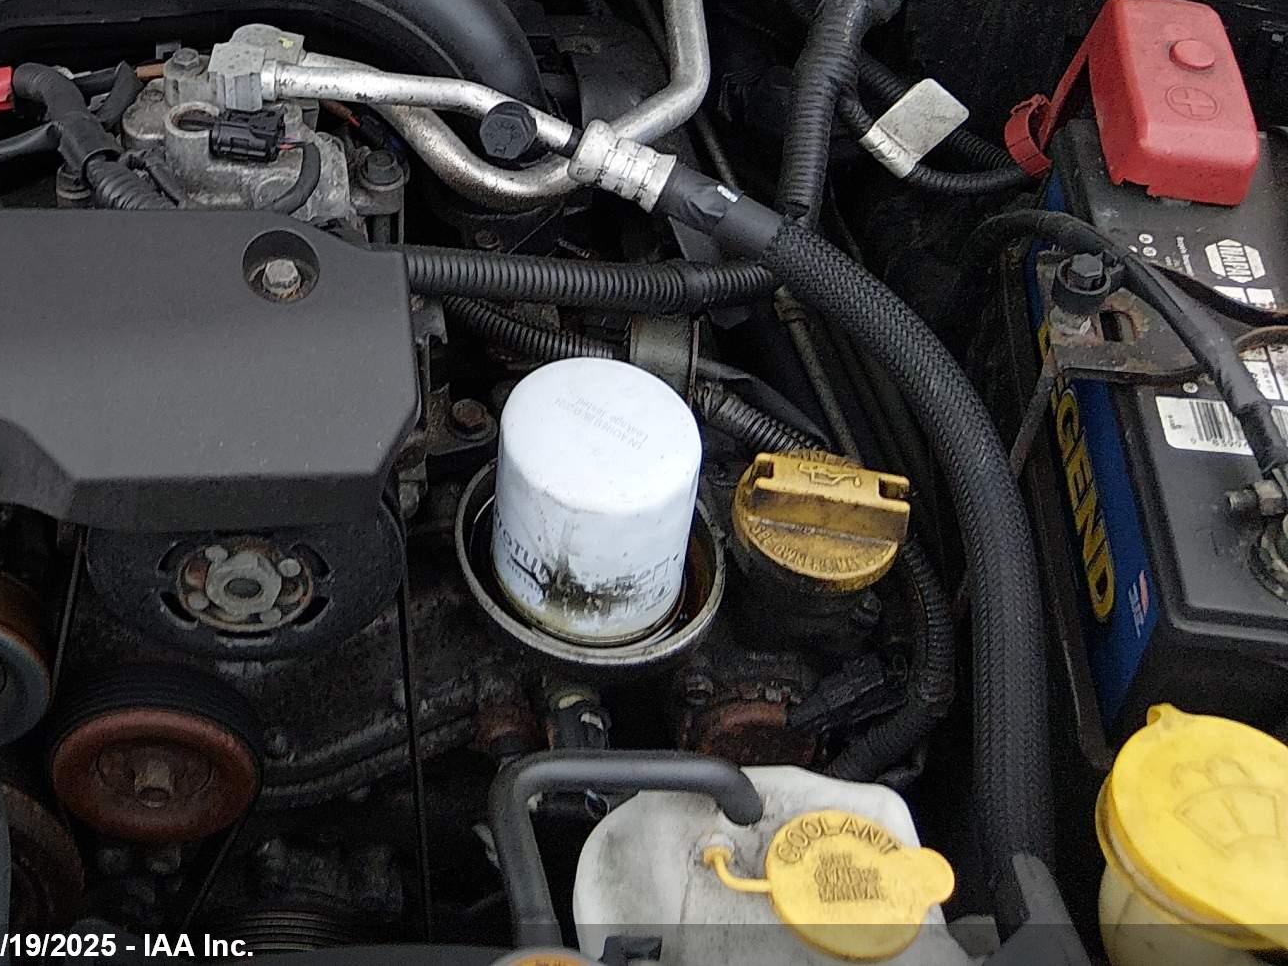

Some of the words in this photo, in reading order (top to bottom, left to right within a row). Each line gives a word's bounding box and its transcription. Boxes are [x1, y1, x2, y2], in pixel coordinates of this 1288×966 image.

[1218, 245, 1253, 277] NAPA
[1053, 384, 1115, 624] GEND
[776, 817, 900, 864] COOLANT
